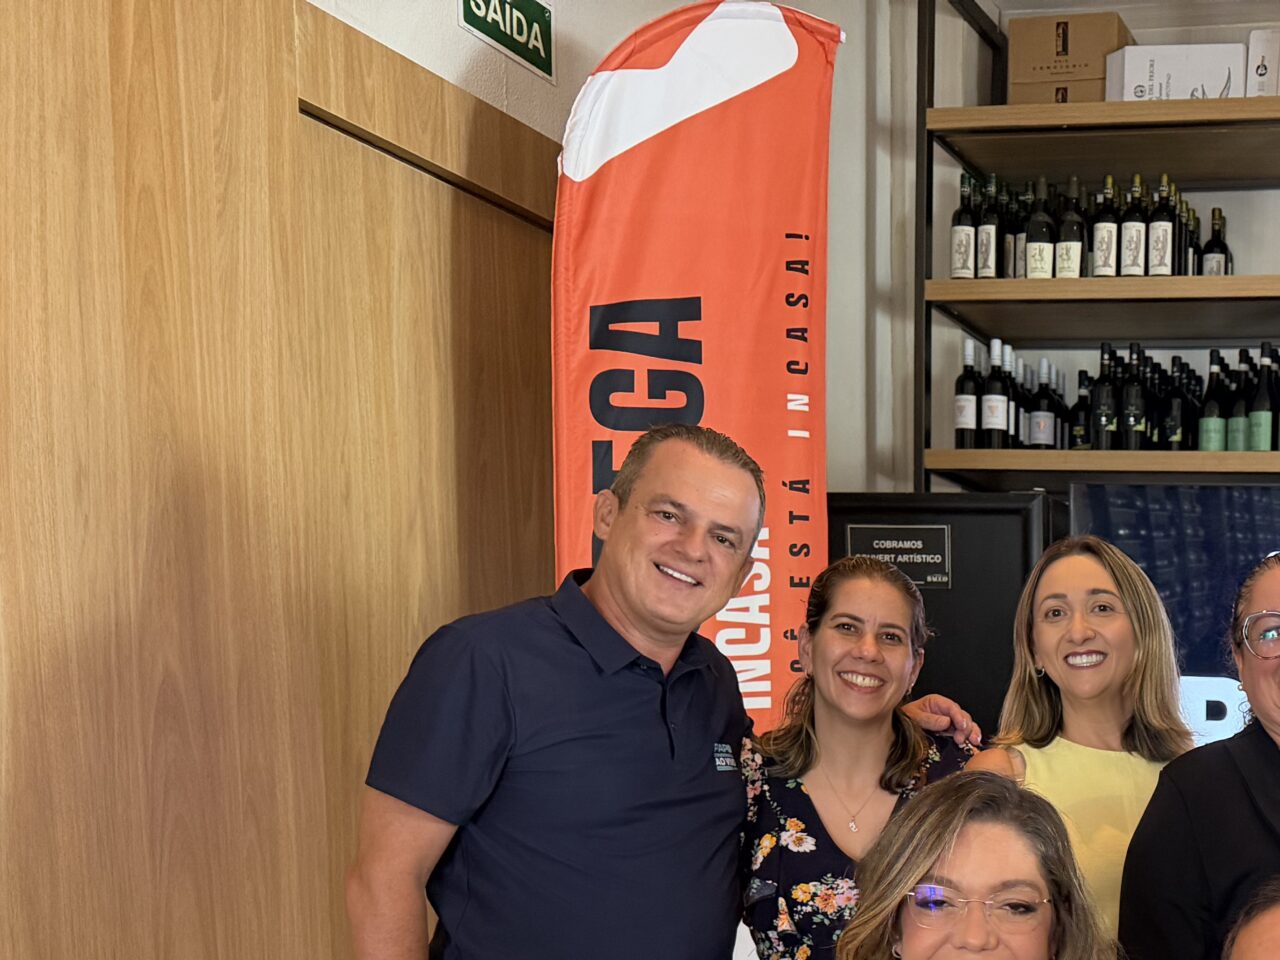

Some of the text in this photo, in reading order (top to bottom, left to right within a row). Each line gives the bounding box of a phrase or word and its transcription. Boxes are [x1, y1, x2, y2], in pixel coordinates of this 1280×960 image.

[782, 232, 811, 588] ESTÁ INCASA!
[873, 540, 923, 549] COBRAMOS
[896, 553, 942, 563] ARTÍSTICO
